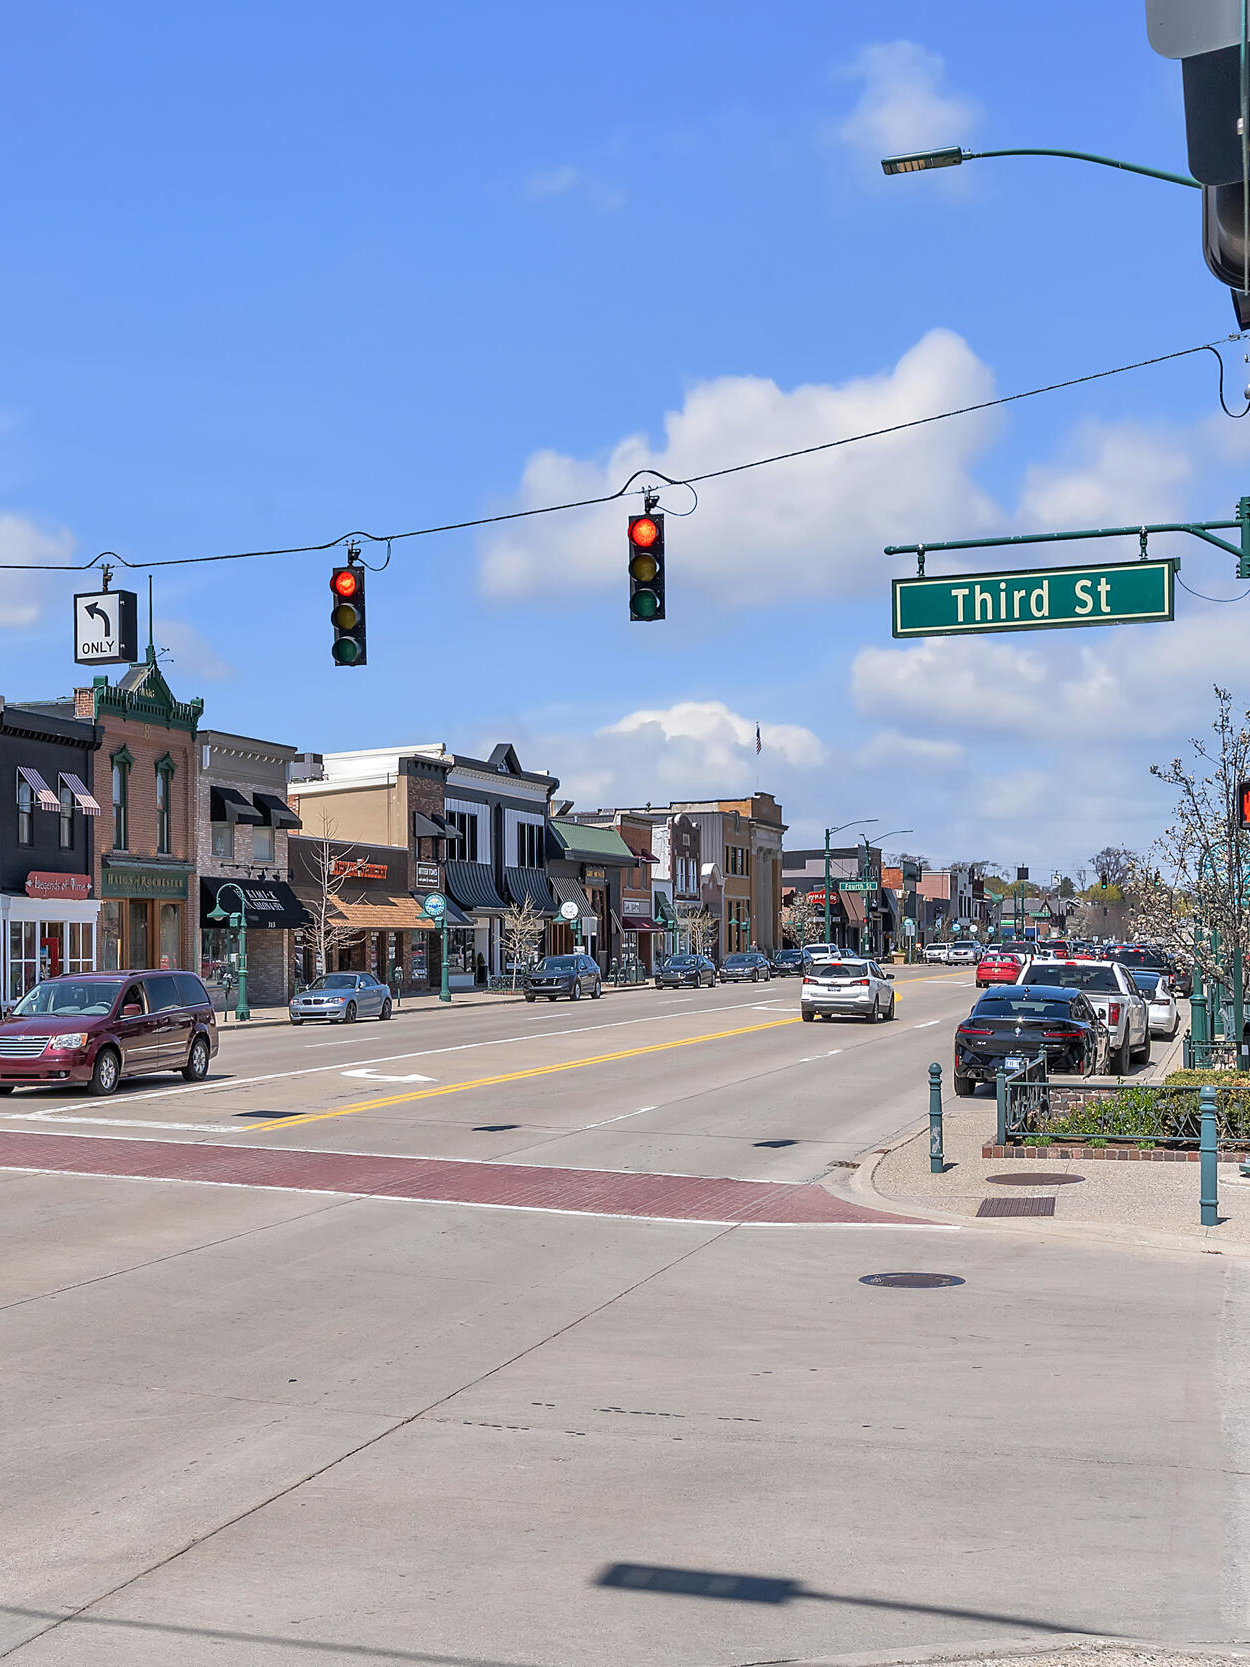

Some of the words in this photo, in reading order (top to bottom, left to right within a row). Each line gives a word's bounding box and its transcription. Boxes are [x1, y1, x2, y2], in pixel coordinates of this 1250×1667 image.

[951, 580, 1049, 622] Third
[1074, 577, 1111, 615] St
[82, 640, 115, 655] ONLY
